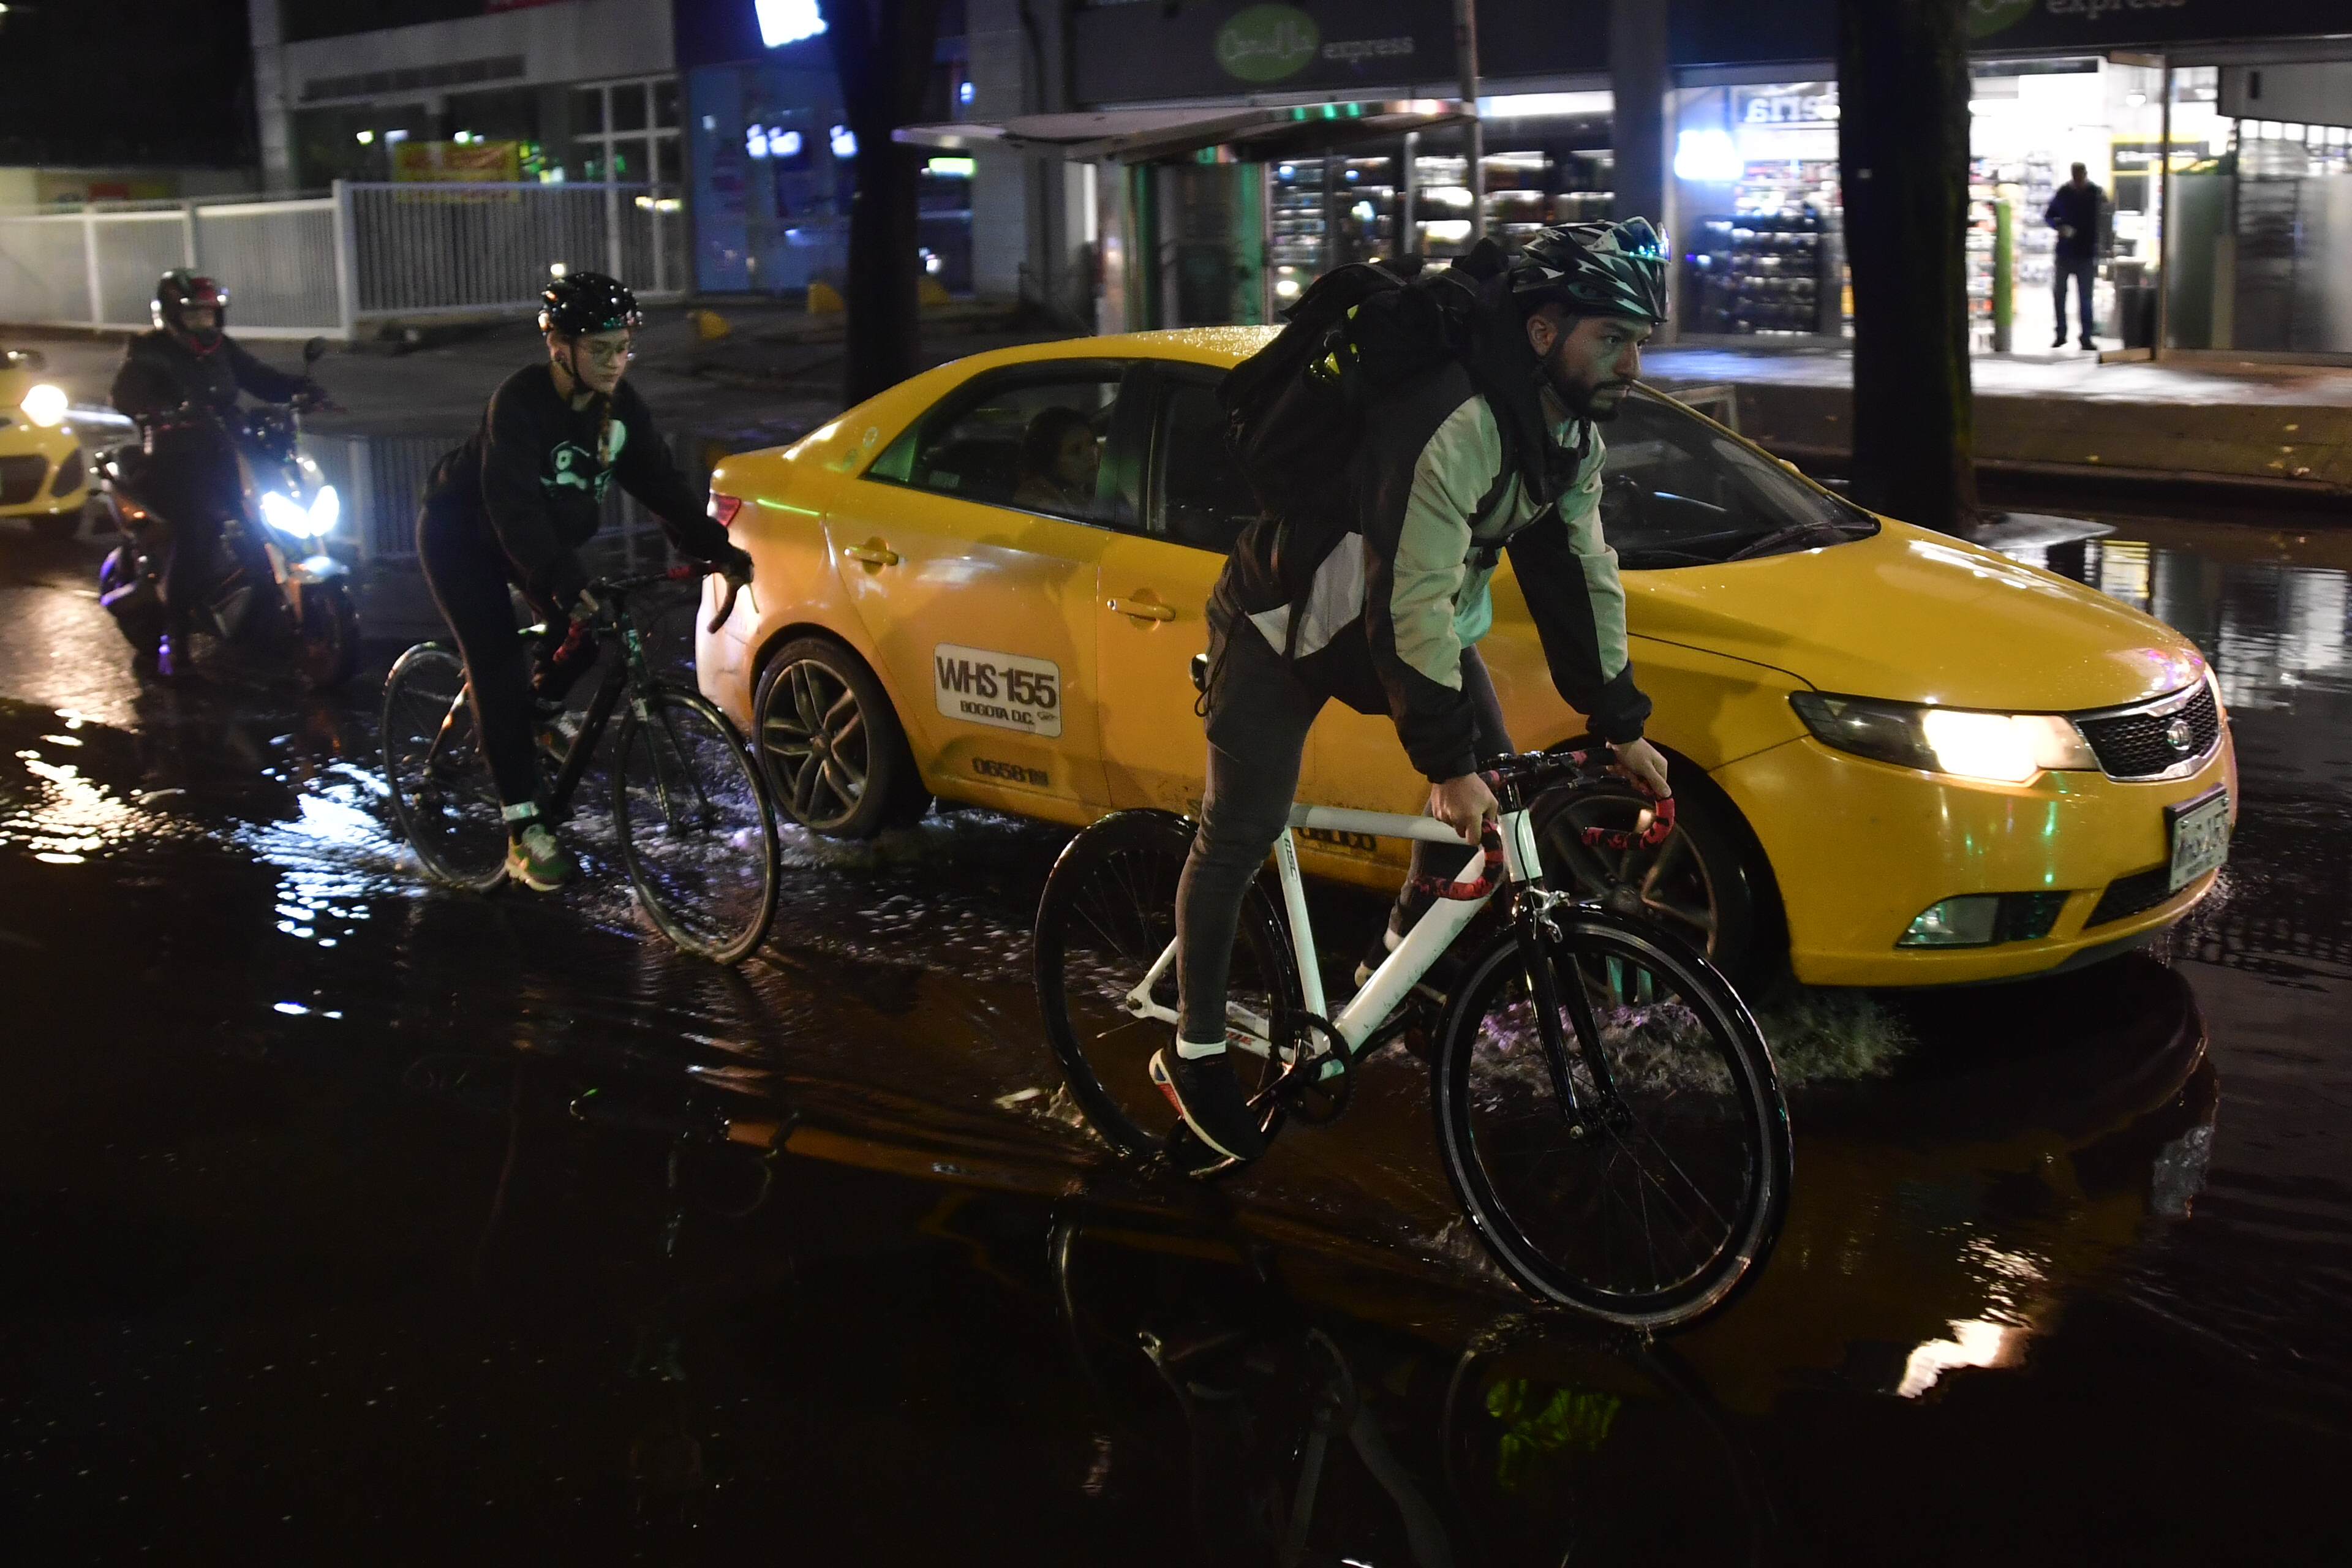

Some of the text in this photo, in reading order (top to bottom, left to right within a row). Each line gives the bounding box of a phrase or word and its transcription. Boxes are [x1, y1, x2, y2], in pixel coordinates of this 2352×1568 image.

[1322, 36, 1415, 64] express
[936, 656, 1057, 709] WHS 155
[1011, 709, 1035, 725] D.C.
